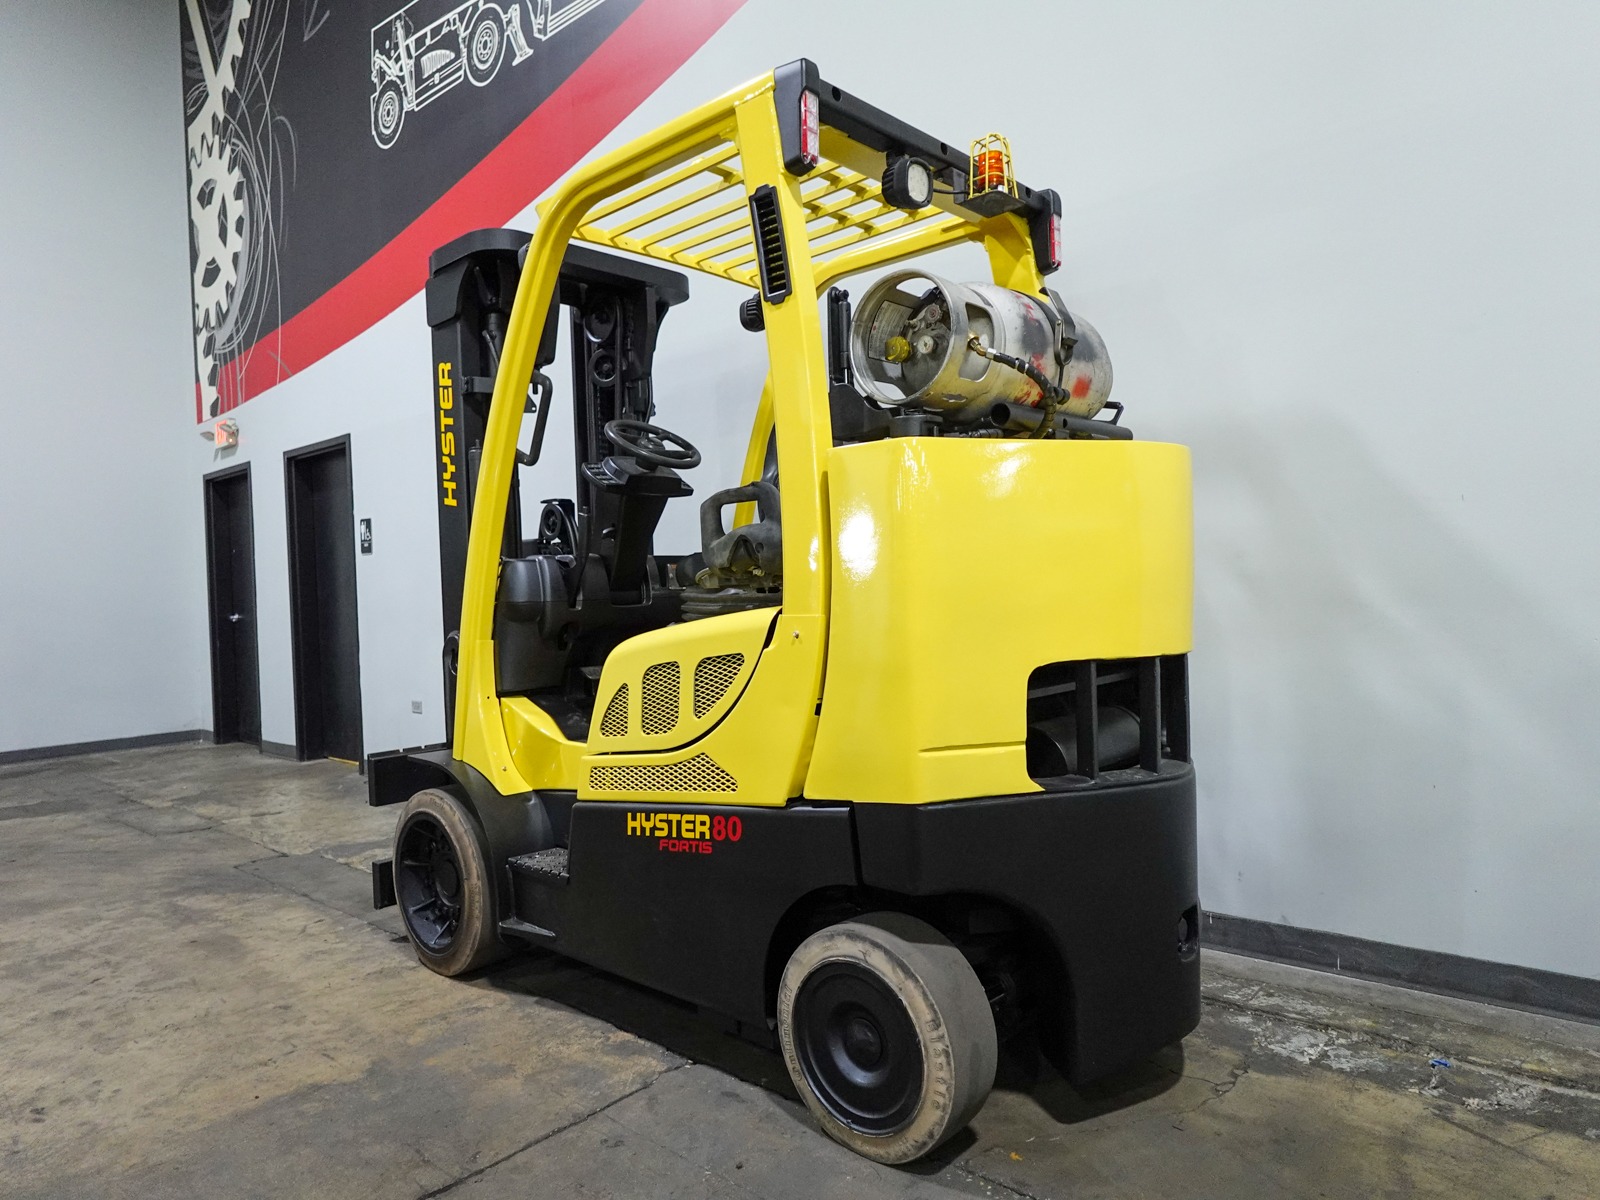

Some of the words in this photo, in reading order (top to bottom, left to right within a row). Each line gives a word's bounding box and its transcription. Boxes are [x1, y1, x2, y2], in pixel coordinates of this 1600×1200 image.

[438, 362, 458, 507] HYSTER
[627, 812, 710, 839] HYSTER
[712, 816, 742, 841] 80
[659, 839, 713, 854] FORTIS
